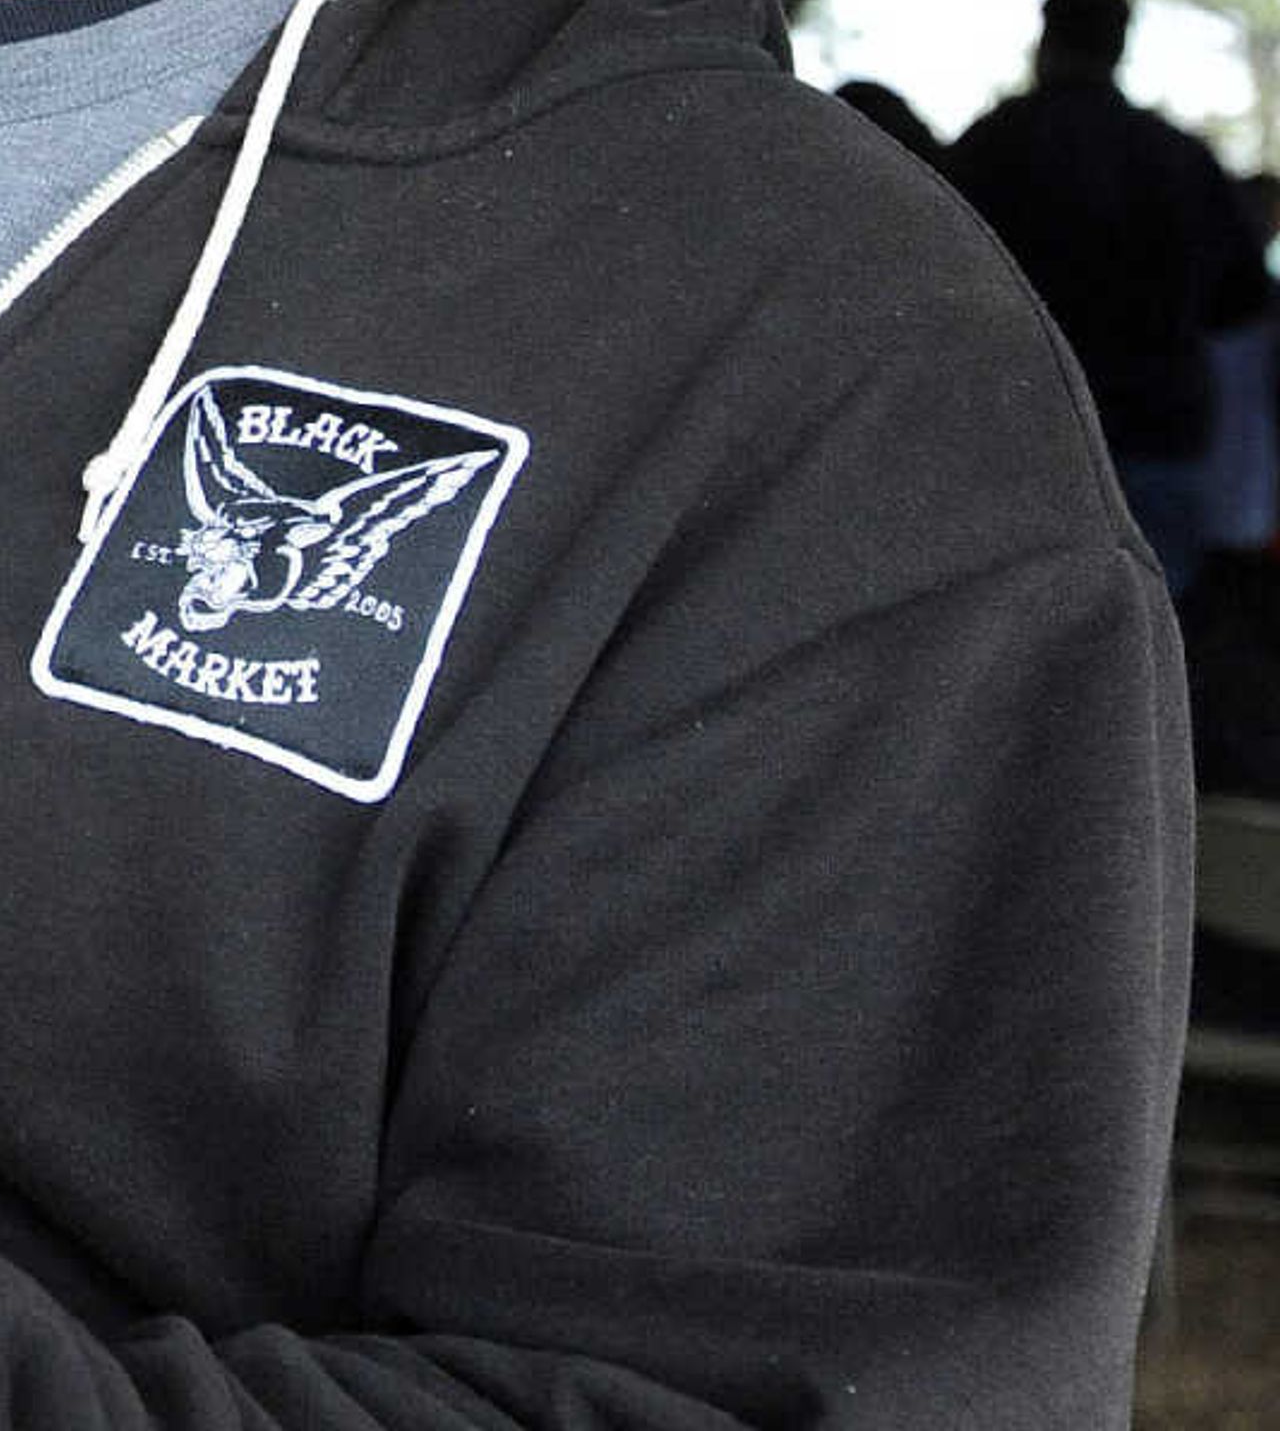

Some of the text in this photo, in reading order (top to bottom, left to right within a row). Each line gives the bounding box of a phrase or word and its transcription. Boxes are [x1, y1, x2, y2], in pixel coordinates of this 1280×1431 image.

[236, 405, 399, 473] BLACK
[344, 591, 407, 632] 2005
[119, 610, 322, 704] MARKET
